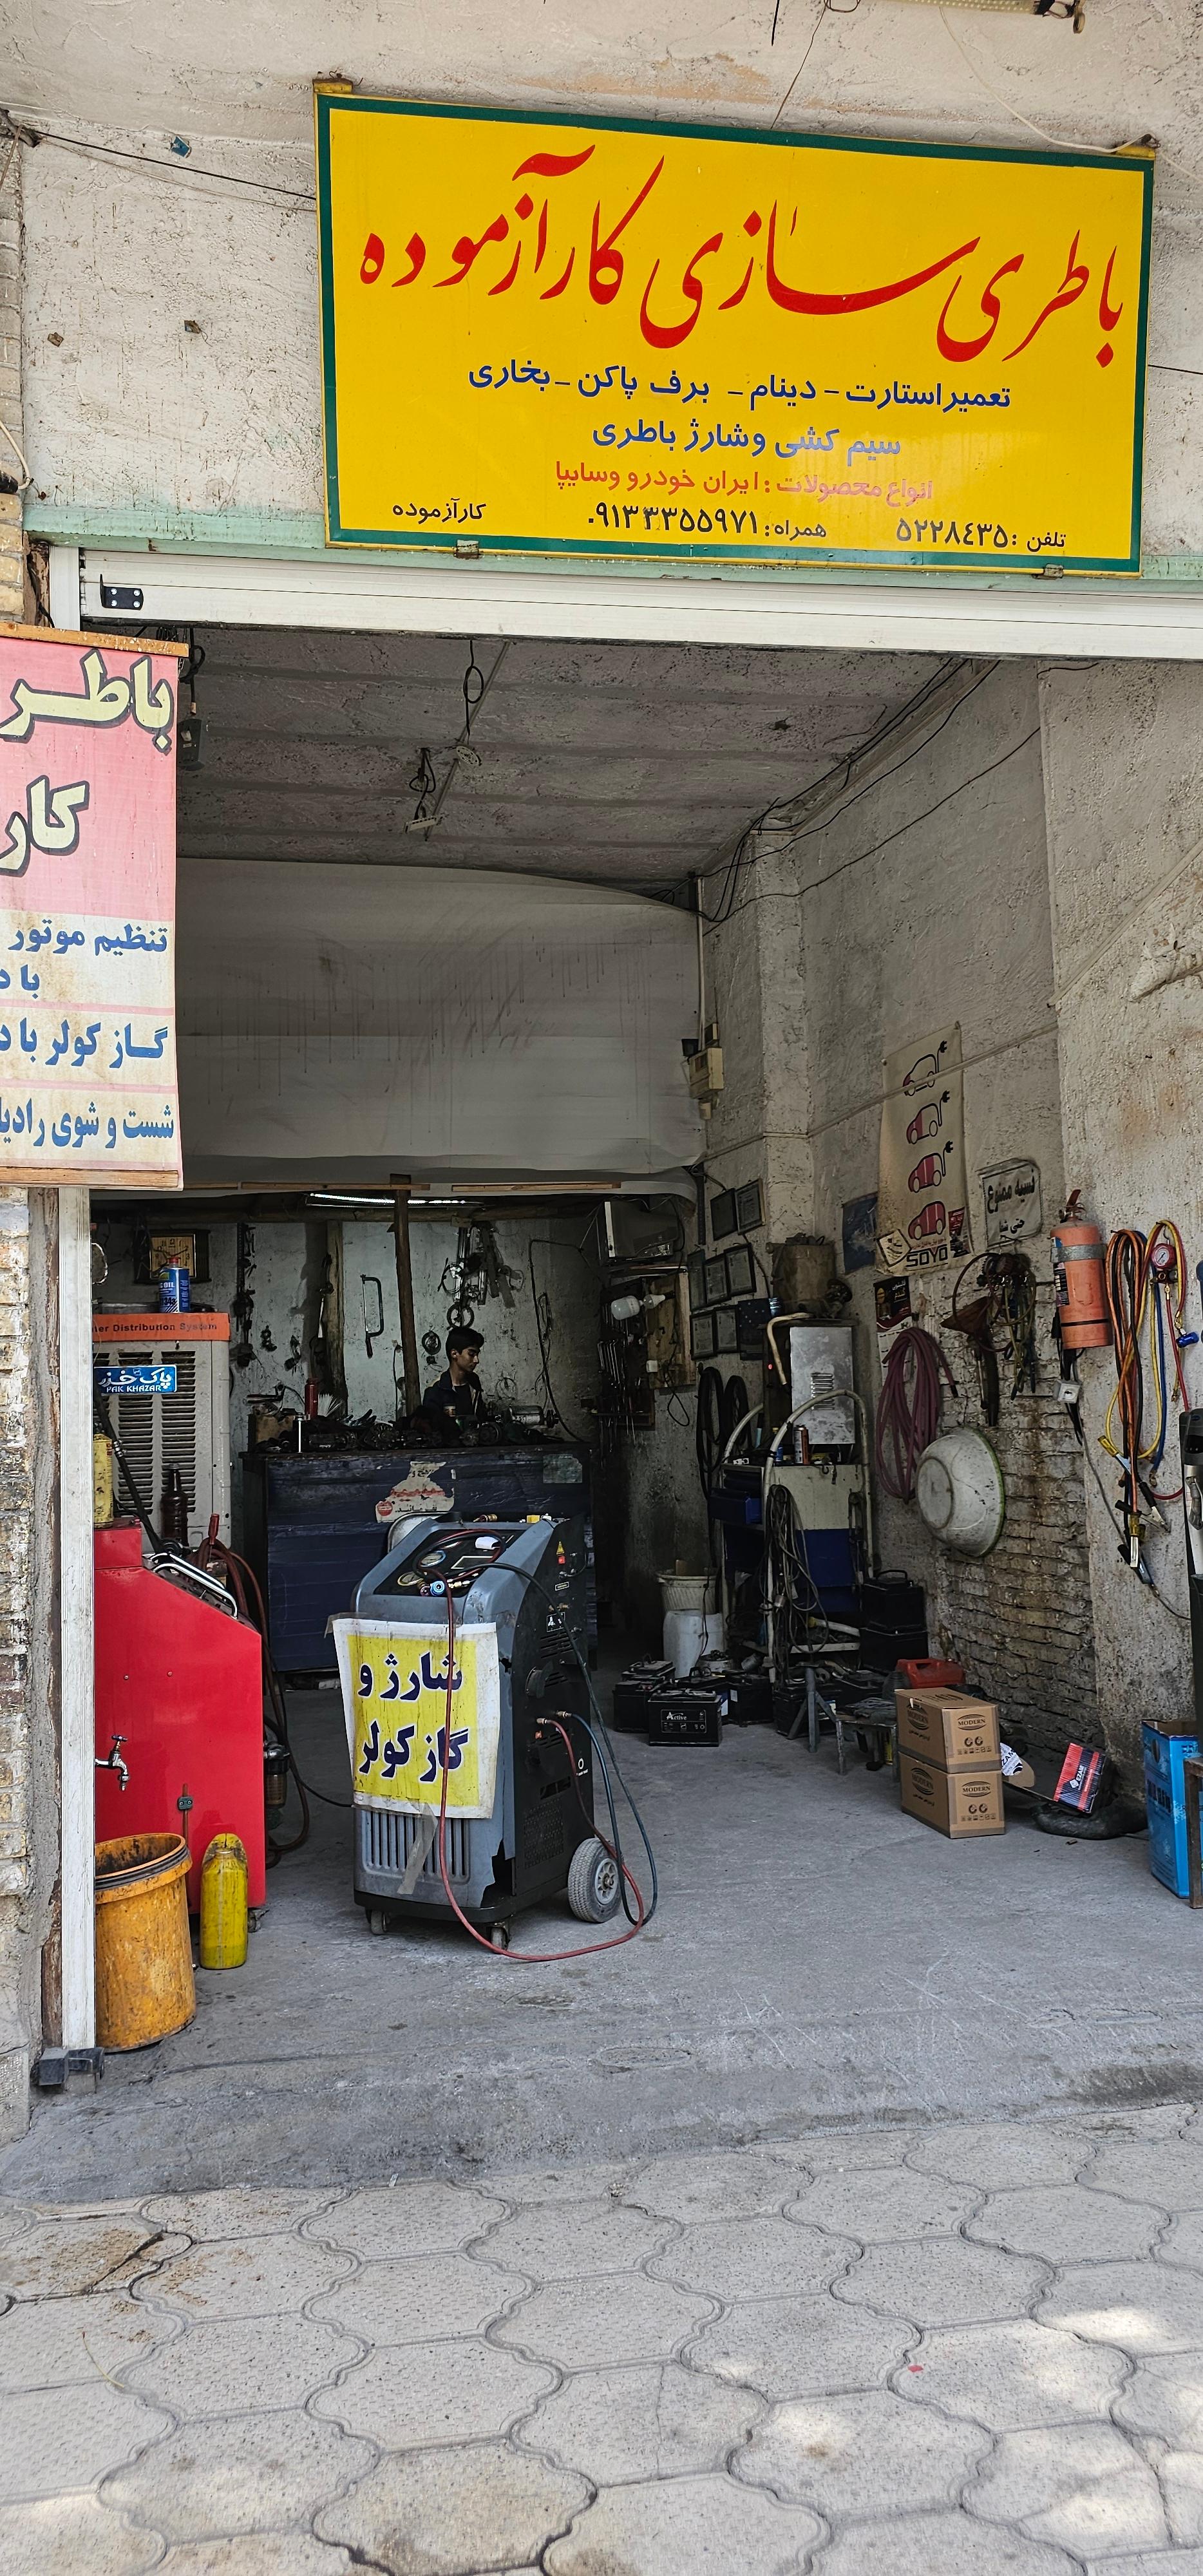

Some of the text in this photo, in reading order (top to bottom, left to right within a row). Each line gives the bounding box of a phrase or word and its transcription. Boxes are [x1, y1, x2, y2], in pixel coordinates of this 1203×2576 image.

[640, 200, 980, 349] سازی
[936, 229, 1123, 368] باطری
[469, 359, 551, 392] بخاری
[579, 365, 638, 399] پاکن
[650, 370, 710, 402] برف
[750, 374, 816, 410] دینام
[592, 419, 676, 451] باطری
[775, 427, 839, 458] کشی
[847, 437, 900, 467] سیم
[627, 469, 696, 495] خودرو
[703, 470, 759, 496] ایران
[886, 480, 933, 507] انواع
[8, 918, 167, 956] تنظیم موتور
[21, 964, 40, 999] با
[20, 1018, 37, 1063] با
[45, 1019, 101, 1066] کولر
[109, 1022, 168, 1068] گاز
[52, 1102, 99, 1148] شوی
[105, 1116, 117, 1148] و
[123, 1104, 174, 1139] شست
[905, 1244, 949, 1267] SOYO
[93, 1323, 217, 1332] ter Distribution System
[98, 1368, 172, 1389] پاک خزر
[106, 1385, 124, 1393] PAK
[357, 1651, 462, 1701] شارژ و
[666, 1712, 687, 1720] Active
[358, 1721, 469, 1783] گاز کولر
